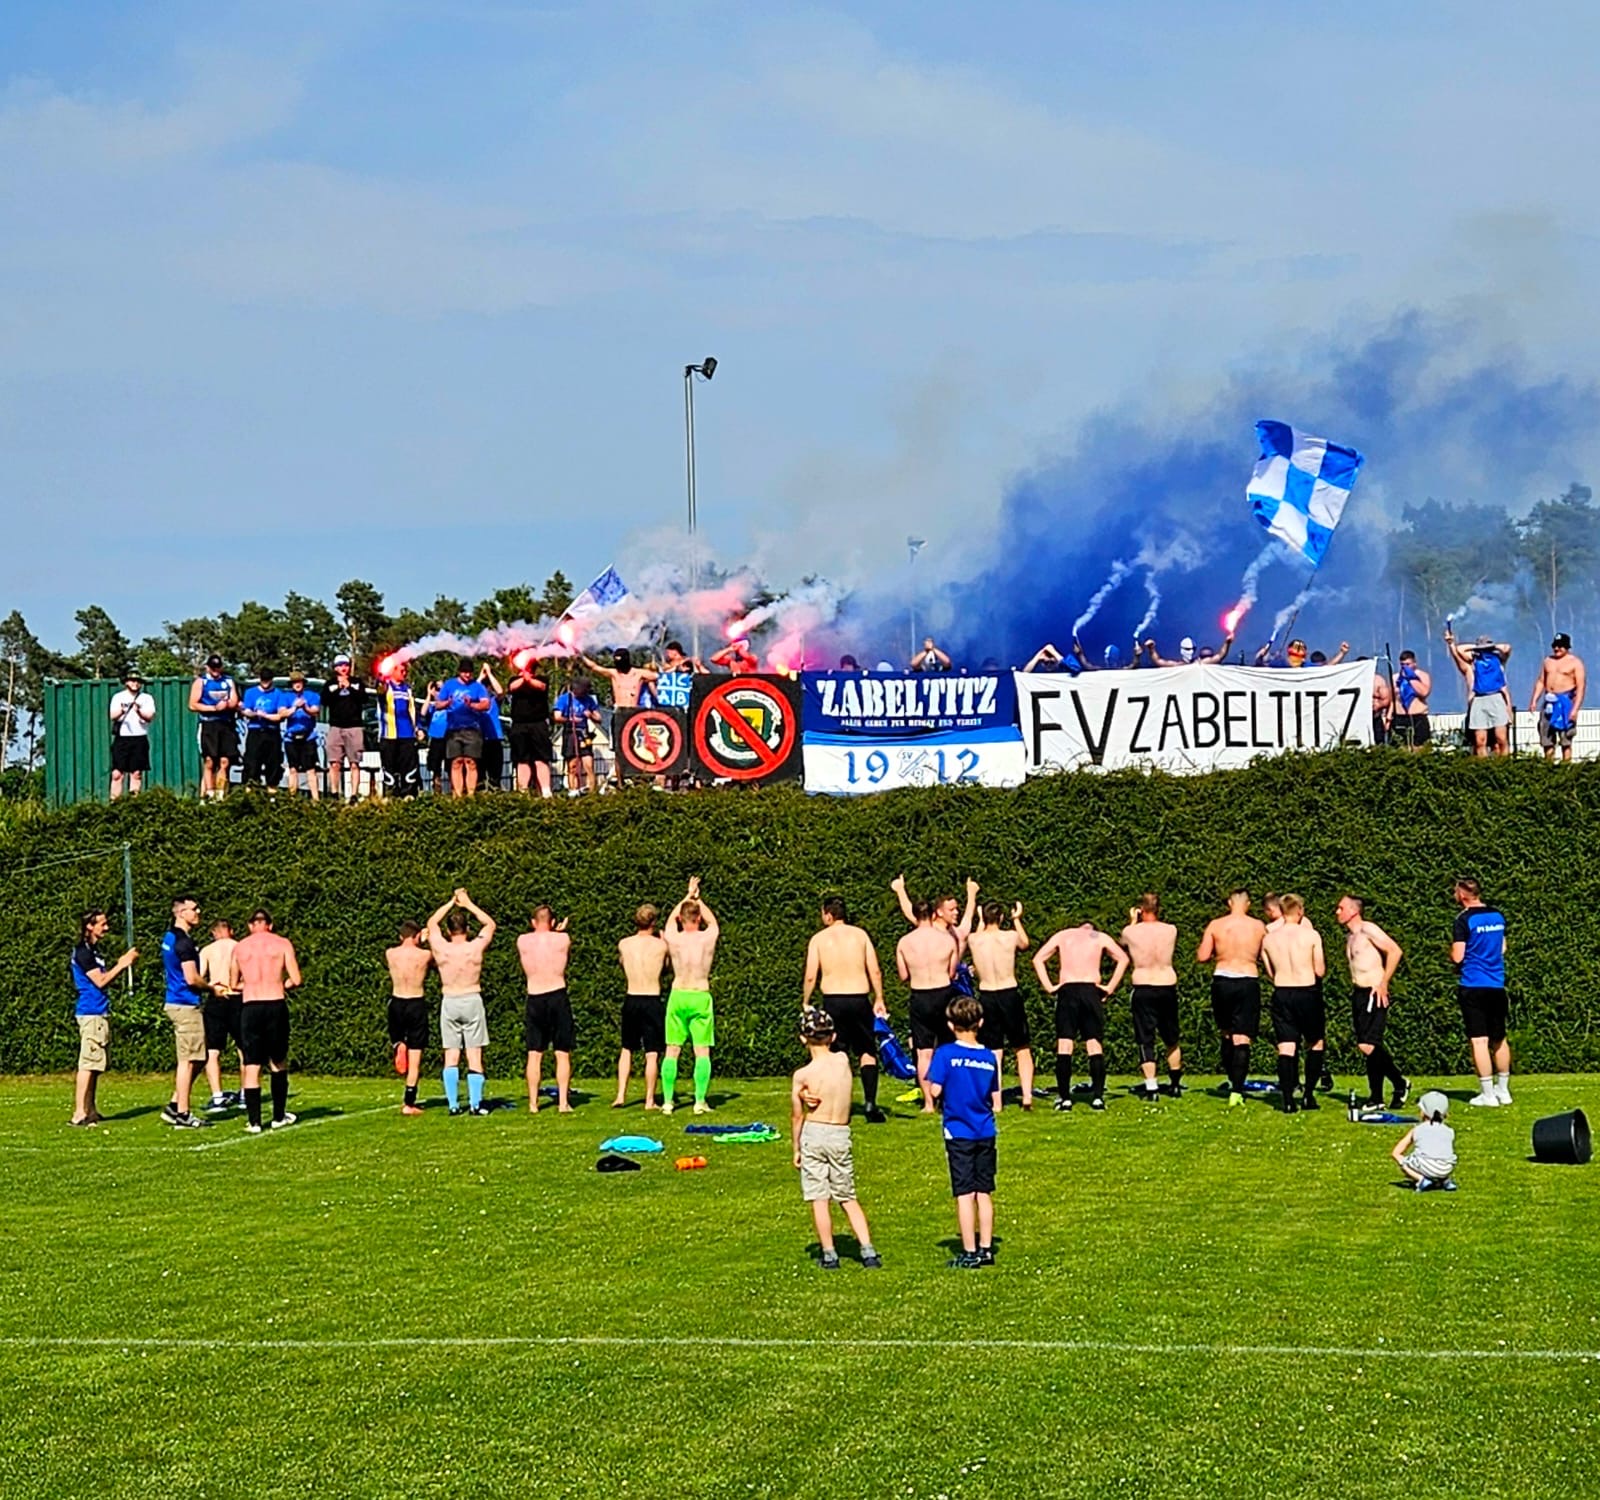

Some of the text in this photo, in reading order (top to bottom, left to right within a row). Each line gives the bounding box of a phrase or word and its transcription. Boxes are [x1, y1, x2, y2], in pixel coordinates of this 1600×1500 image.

[816, 676, 998, 718] ZABELTITZ
[1030, 687, 1362, 767] FV ZABELTITZ
